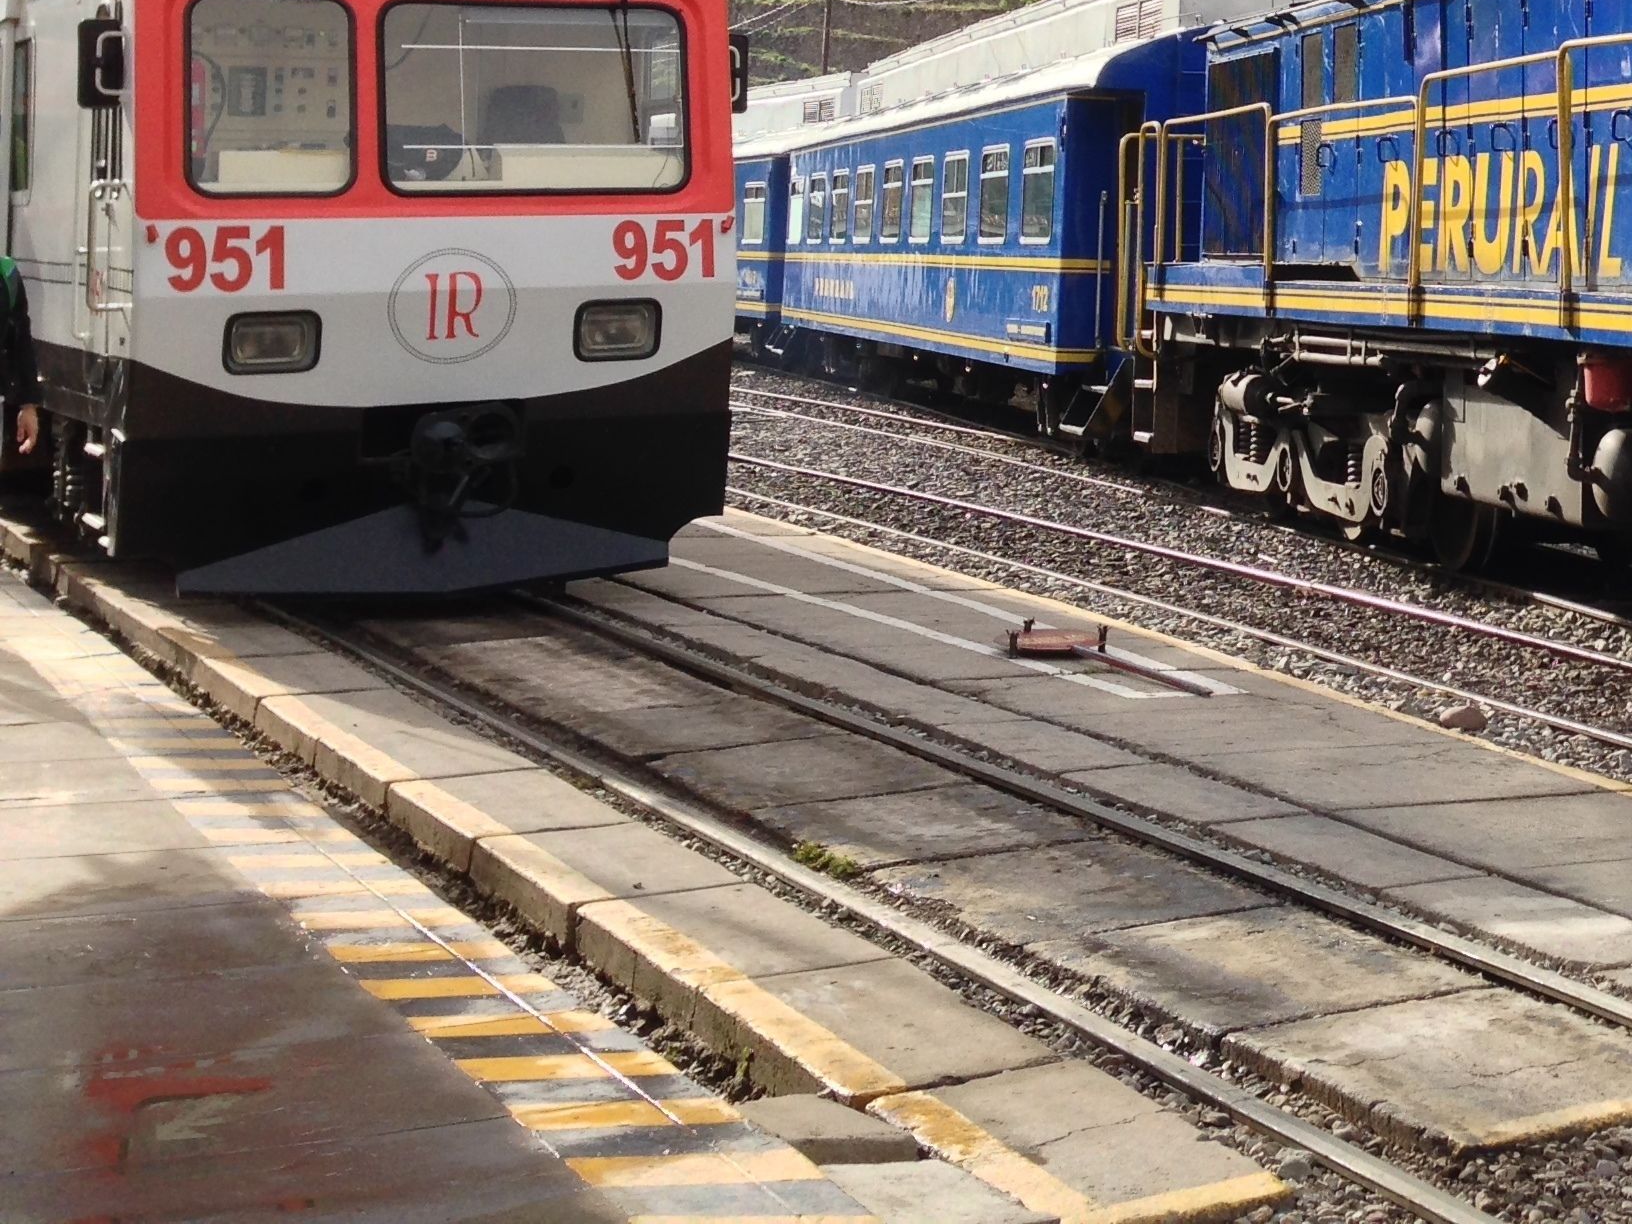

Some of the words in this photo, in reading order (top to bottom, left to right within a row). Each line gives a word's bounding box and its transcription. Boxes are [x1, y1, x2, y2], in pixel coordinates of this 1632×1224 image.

[1378, 143, 1622, 277] PERURAIL
[164, 225, 285, 292] 951
[612, 218, 715, 281] 951
[424, 271, 482, 340] IR
